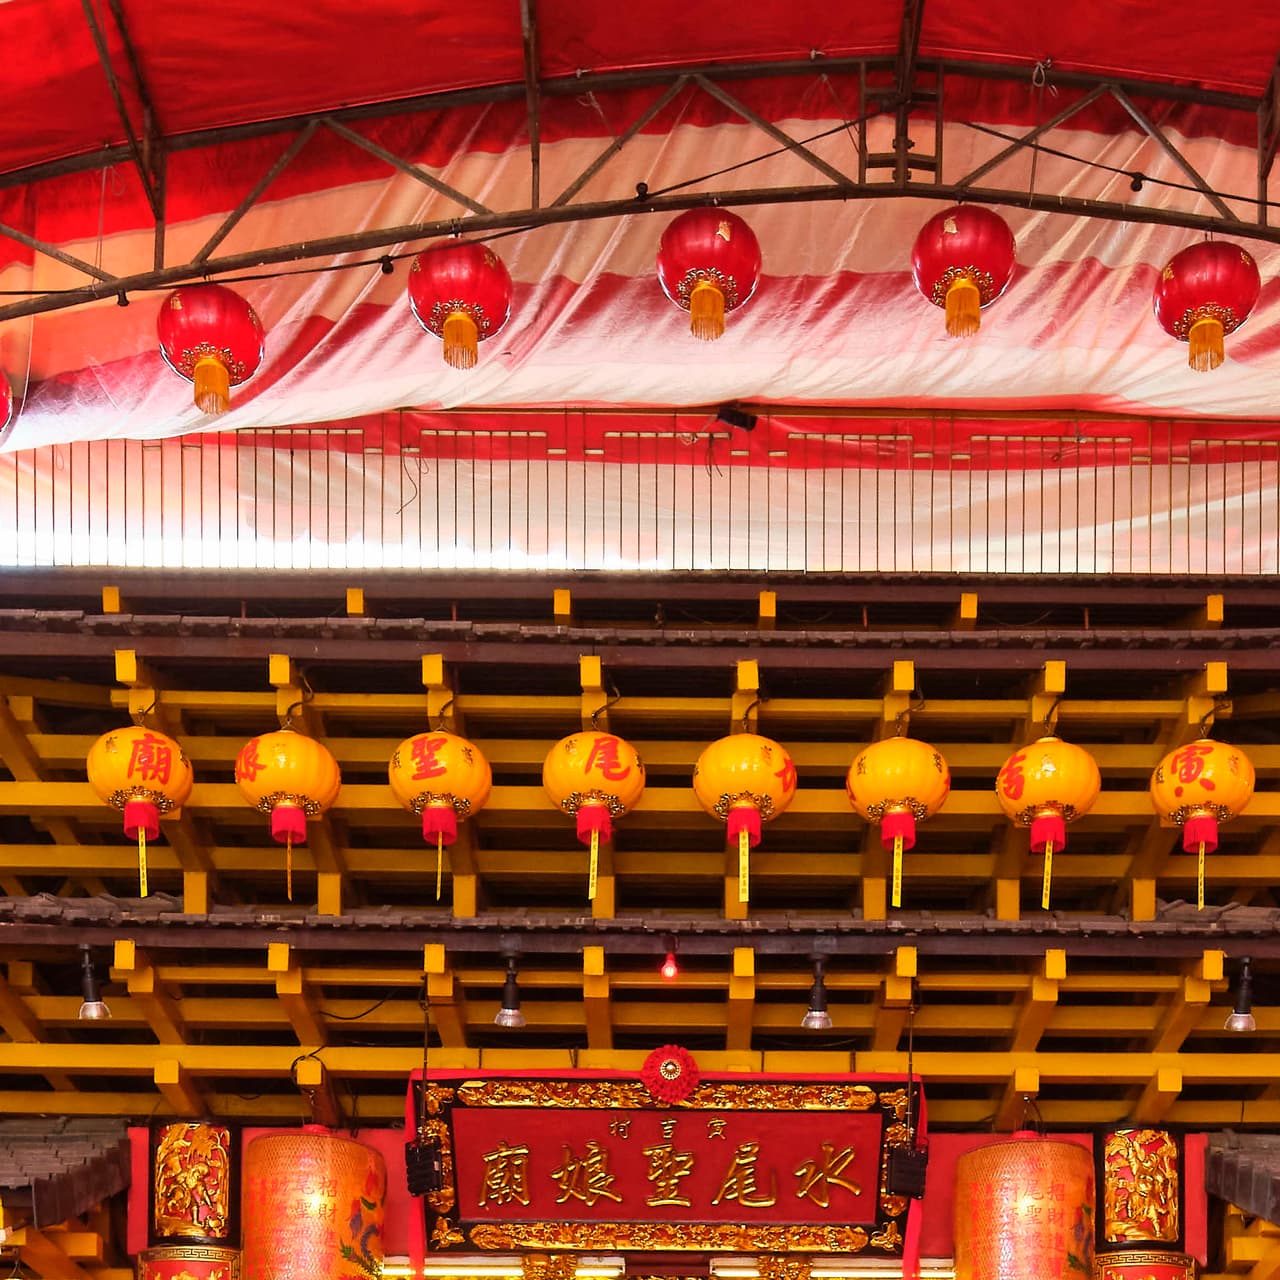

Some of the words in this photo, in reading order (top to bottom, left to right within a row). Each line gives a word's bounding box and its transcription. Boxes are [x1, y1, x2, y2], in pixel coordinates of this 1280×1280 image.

[609, 1118, 728, 1140] 寅吉村
[479, 1141, 861, 1208] 水尾聖娘廟
